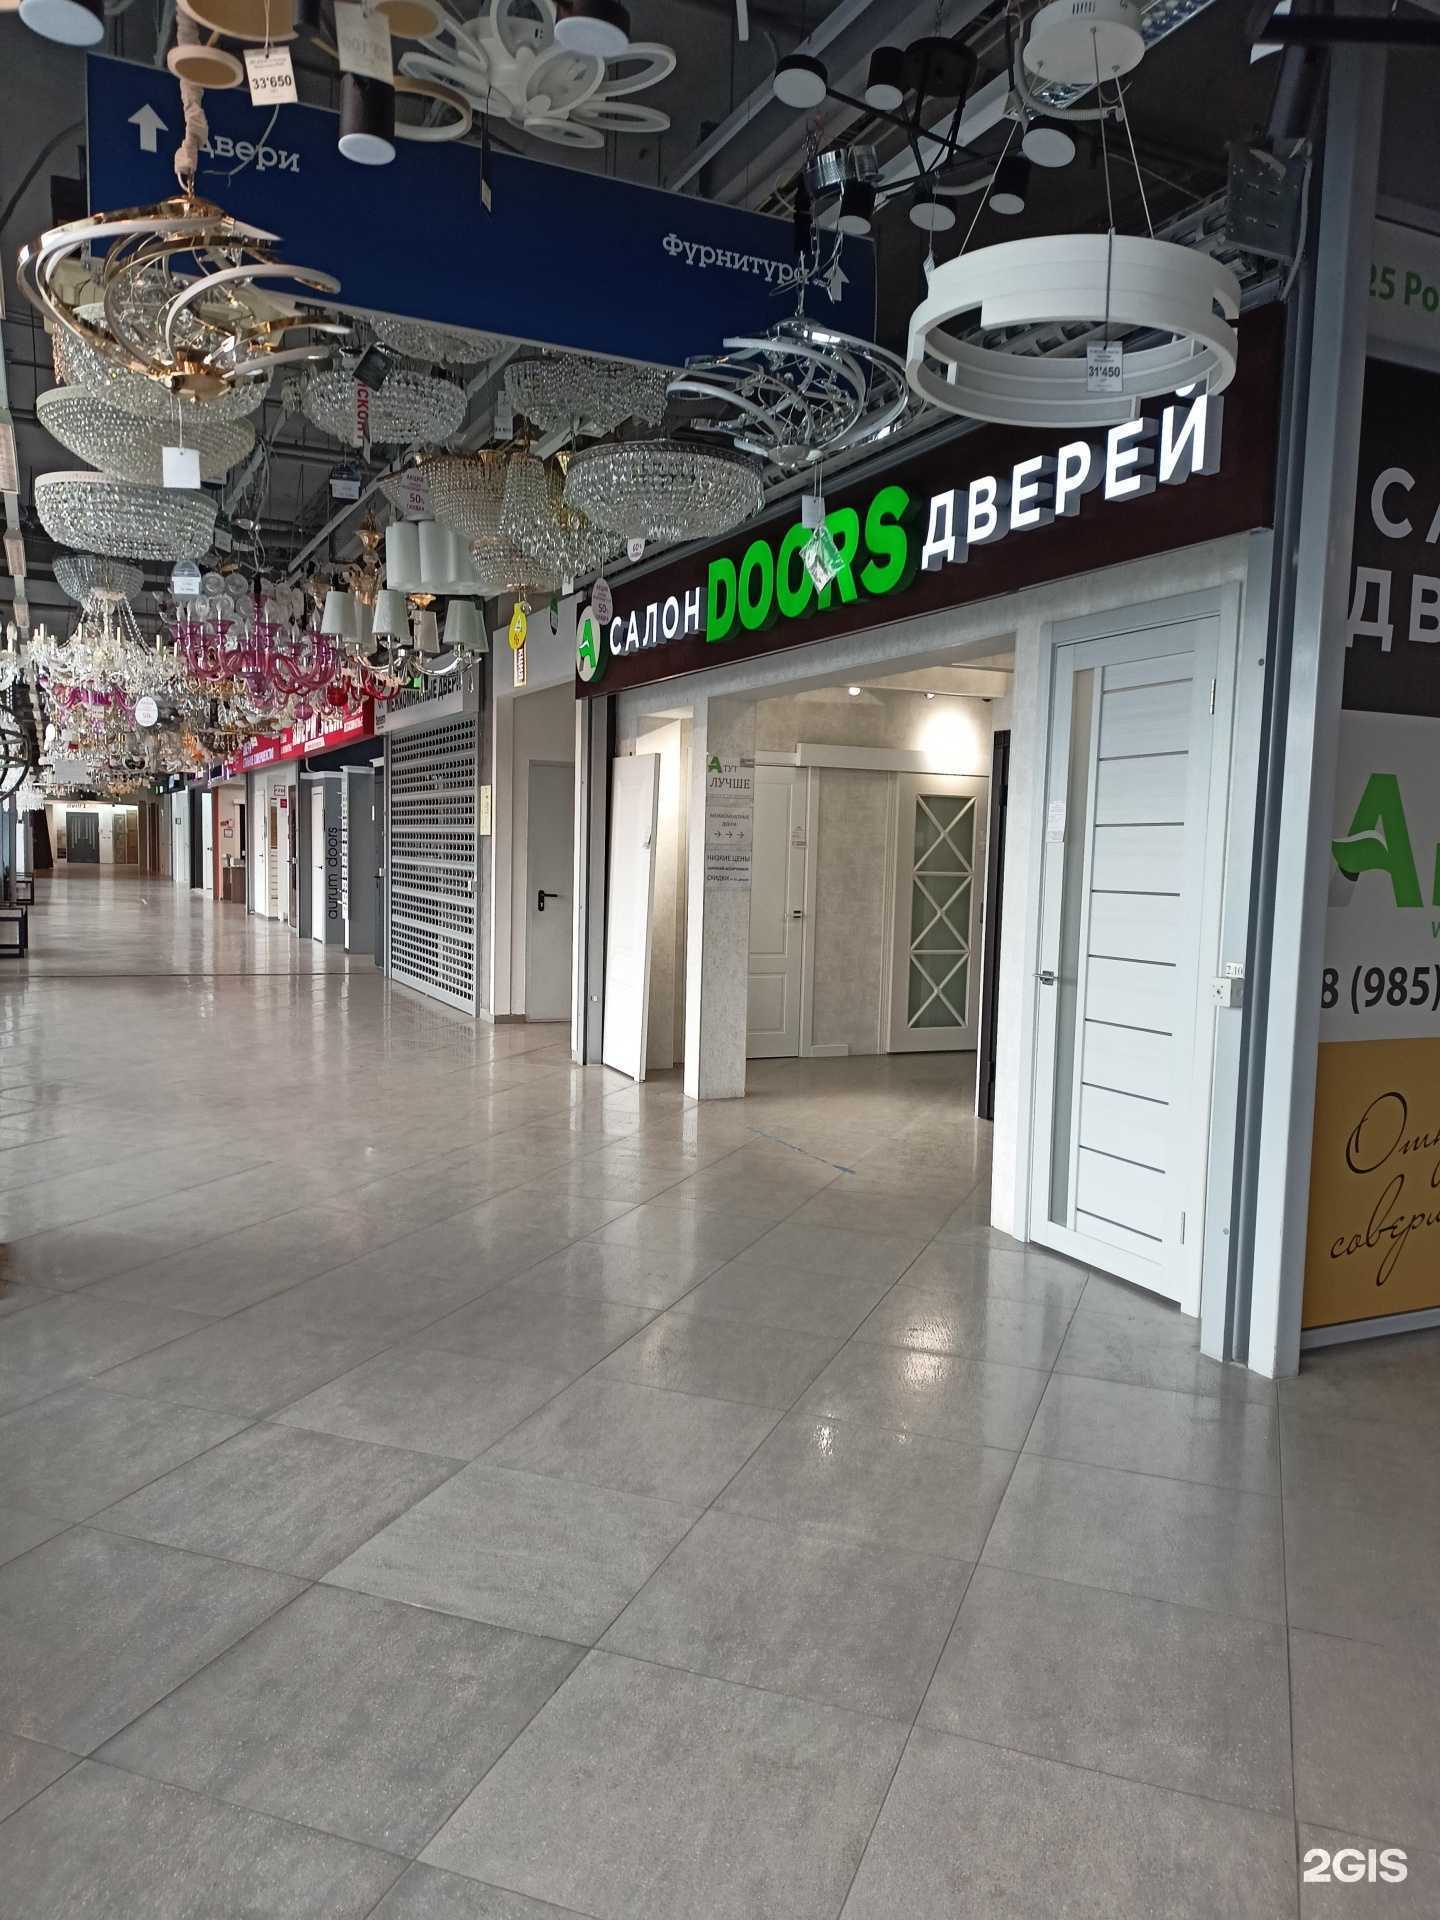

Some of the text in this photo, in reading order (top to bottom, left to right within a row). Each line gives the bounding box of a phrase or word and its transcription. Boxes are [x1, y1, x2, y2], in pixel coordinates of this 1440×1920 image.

[252, 74, 292, 90] 33'650
[1088, 366, 1121, 378] 31'450
[609, 588, 701, 656] САЛОН
[706, 486, 911, 643] DOORS
[921, 384, 1212, 571] ДВЕРЕЙ
[709, 777, 751, 789] ЛУЧШЕ
[325, 826, 338, 920] aurum doors
